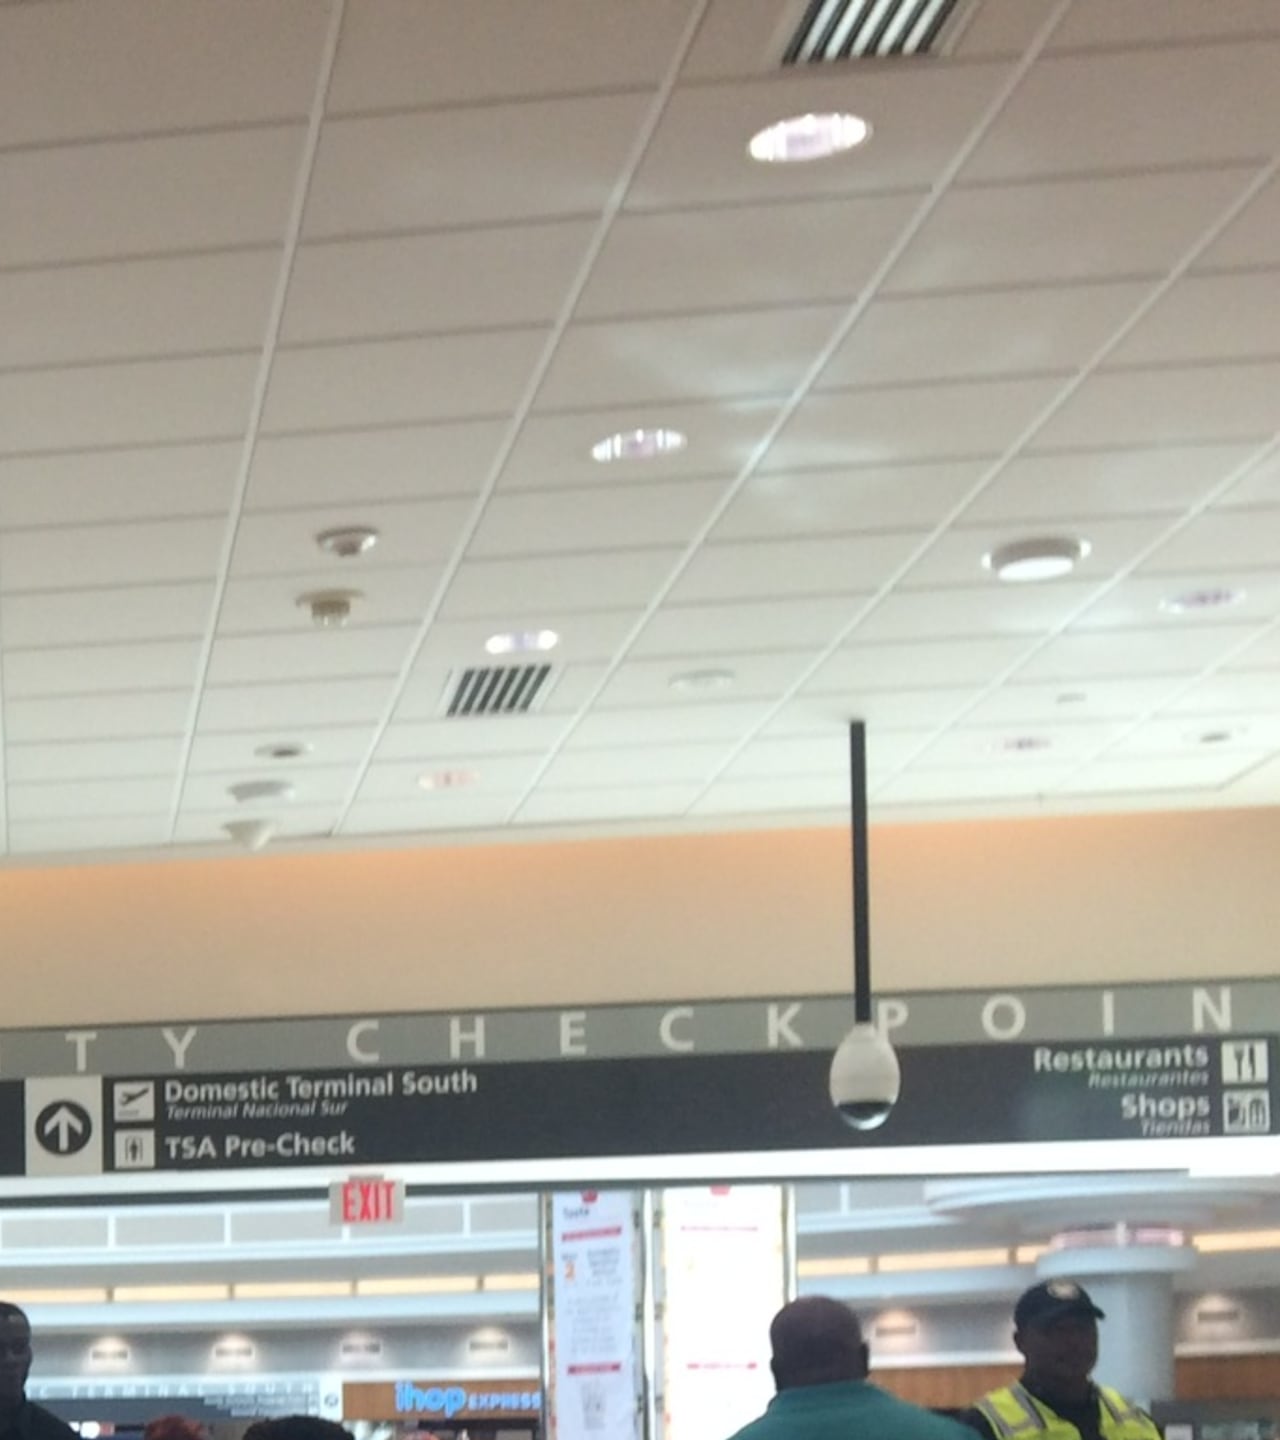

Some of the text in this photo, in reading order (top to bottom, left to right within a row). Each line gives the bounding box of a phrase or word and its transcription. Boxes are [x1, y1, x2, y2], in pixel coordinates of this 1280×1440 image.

[345, 987, 1232, 1063] CHECKPOIN
[1034, 1043, 1209, 1073] Restaurants
[165, 1068, 477, 1102] Domestic Terminal South
[1088, 1069, 1209, 1089] Restaurantes
[167, 1099, 348, 1120] Terminal Nacional Sur
[1121, 1092, 1210, 1120] Shops
[1142, 1118, 1210, 1137] Tiendas
[165, 1130, 356, 1160] TSA Pre-Check
[342, 1182, 395, 1223] EXIT
[395, 1380, 466, 1418] ihop
